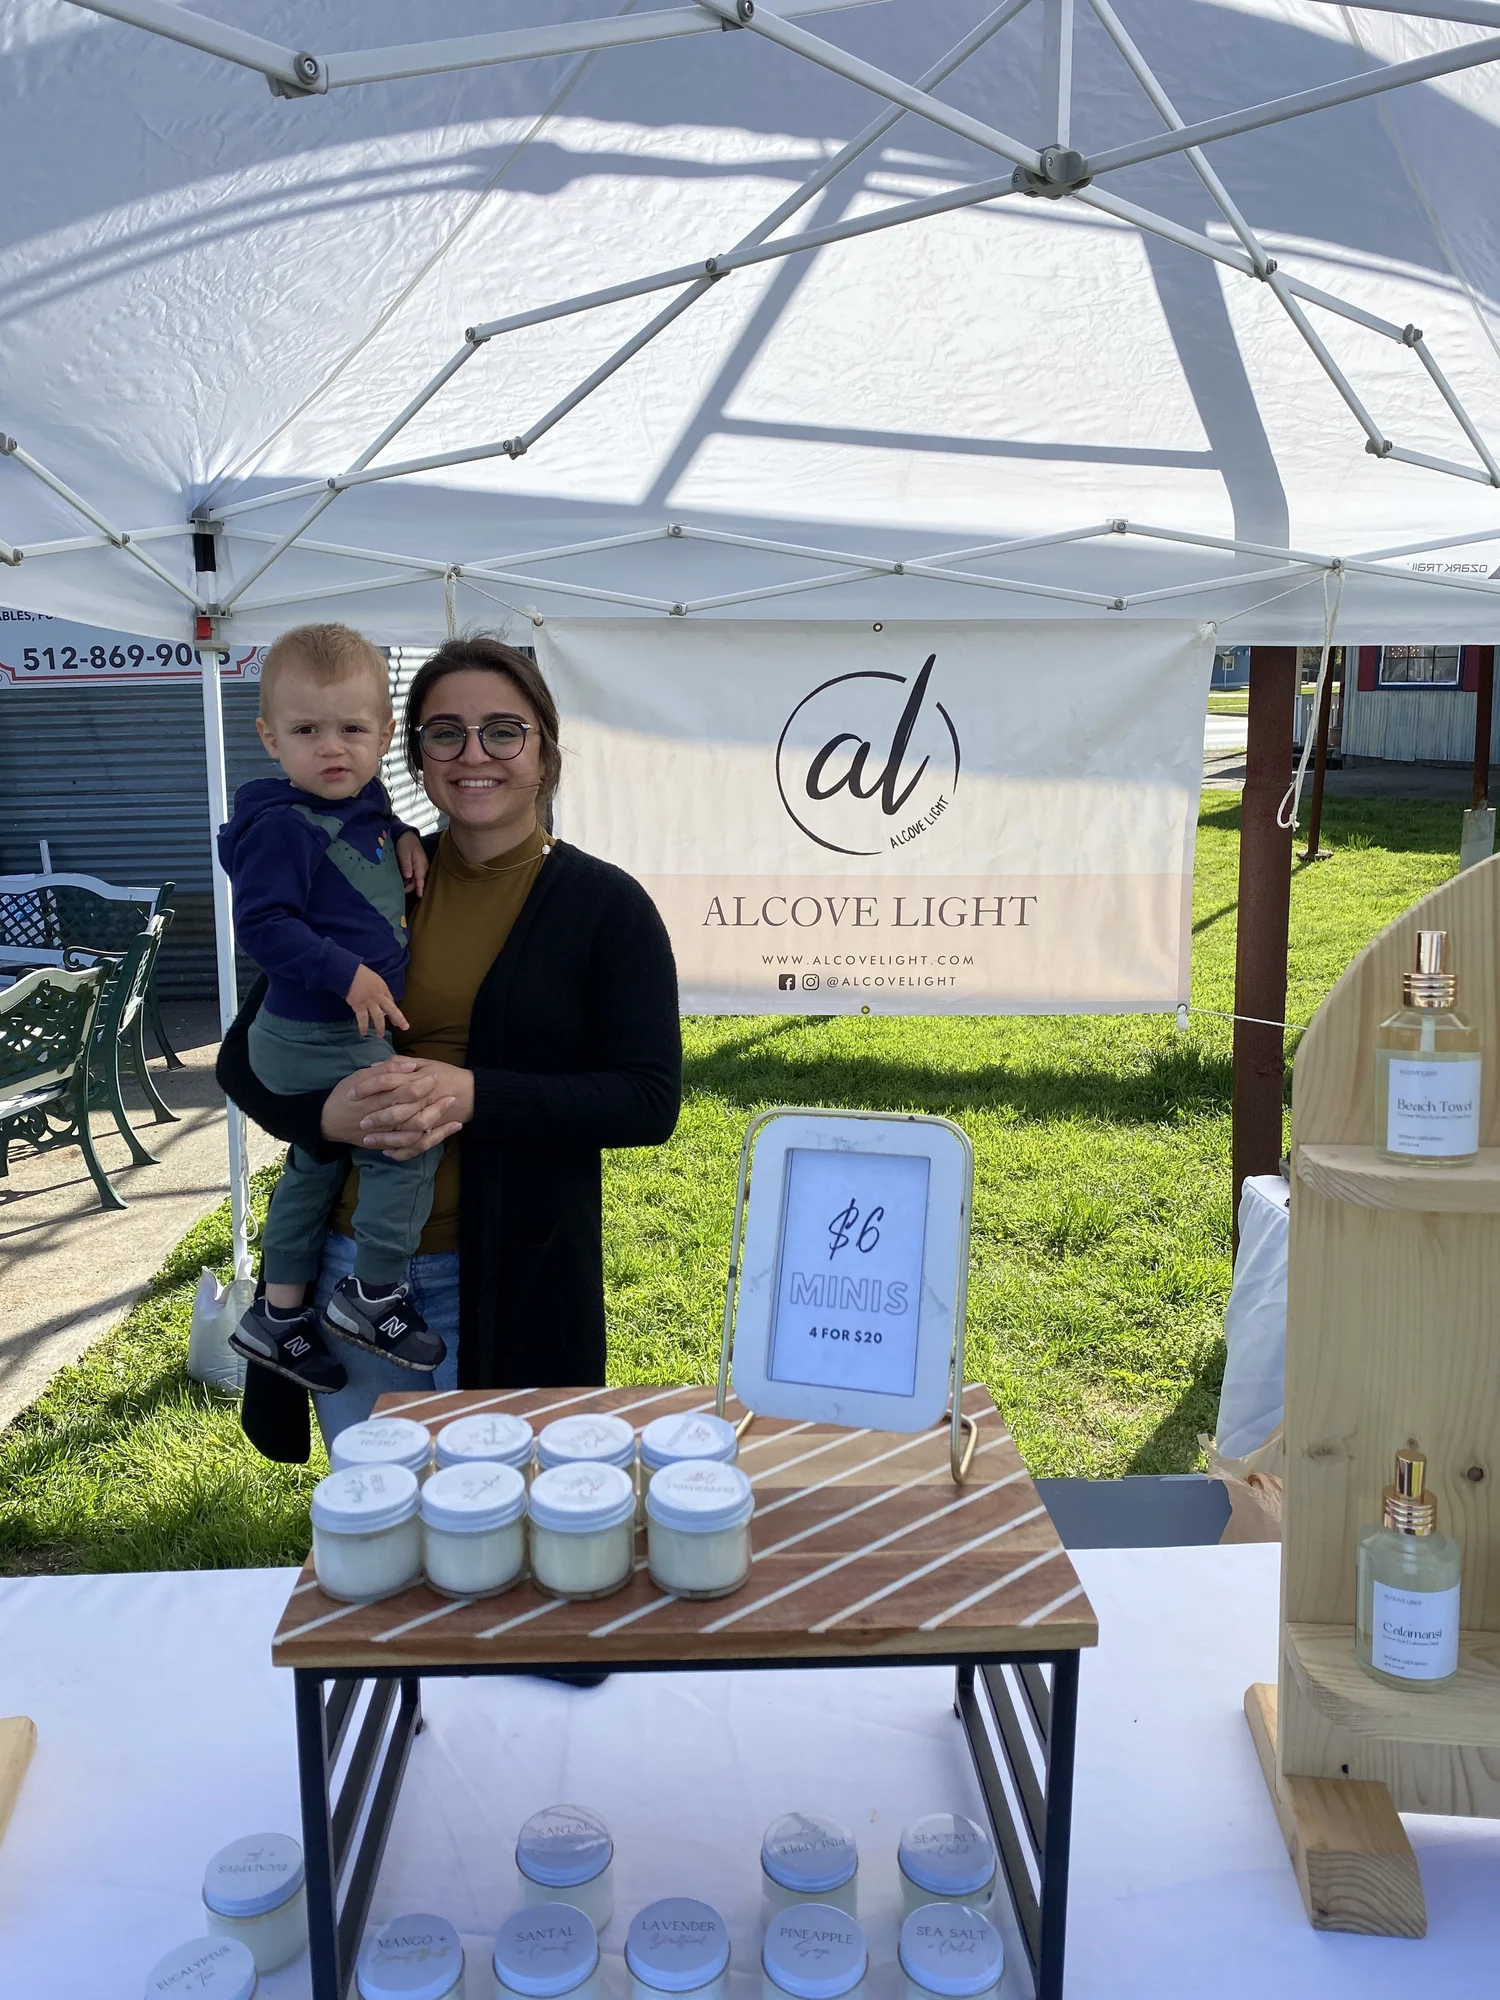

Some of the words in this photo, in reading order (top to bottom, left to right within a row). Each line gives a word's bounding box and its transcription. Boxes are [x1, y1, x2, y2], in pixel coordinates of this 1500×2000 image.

[0, 610, 35, 621] BLES,
[23, 642, 231, 671] 512-869-90
[889, 819, 927, 849] ALCOVE
[923, 794, 949, 826] LIGHT
[702, 895, 880, 927] ALCOVE
[890, 895, 1038, 927] LIGHT
[761, 954, 976, 966] WWW.ALCOVELIGHT.COM
[826, 975, 957, 988] @ALCOVELIGHT
[1397, 1097, 1436, 1113] Beach
[828, 1197, 885, 1261] $6
[790, 1271, 909, 1316] MINIS
[809, 1326, 818, 1339] 4
[821, 1327, 850, 1342] FOR
[854, 1329, 883, 1344] $20
[1383, 1621, 1443, 1640] Calamansi
[914, 1834, 940, 1844] SEA
[516, 1926, 576, 1944] SANTAL
[642, 1920, 716, 1932] LAVENDER
[916, 1925, 944, 1938] SEA
[949, 1928, 987, 1941] SALT
[376, 1933, 434, 1950] MANGO
[780, 1927, 853, 1945] PINEAPPLE
